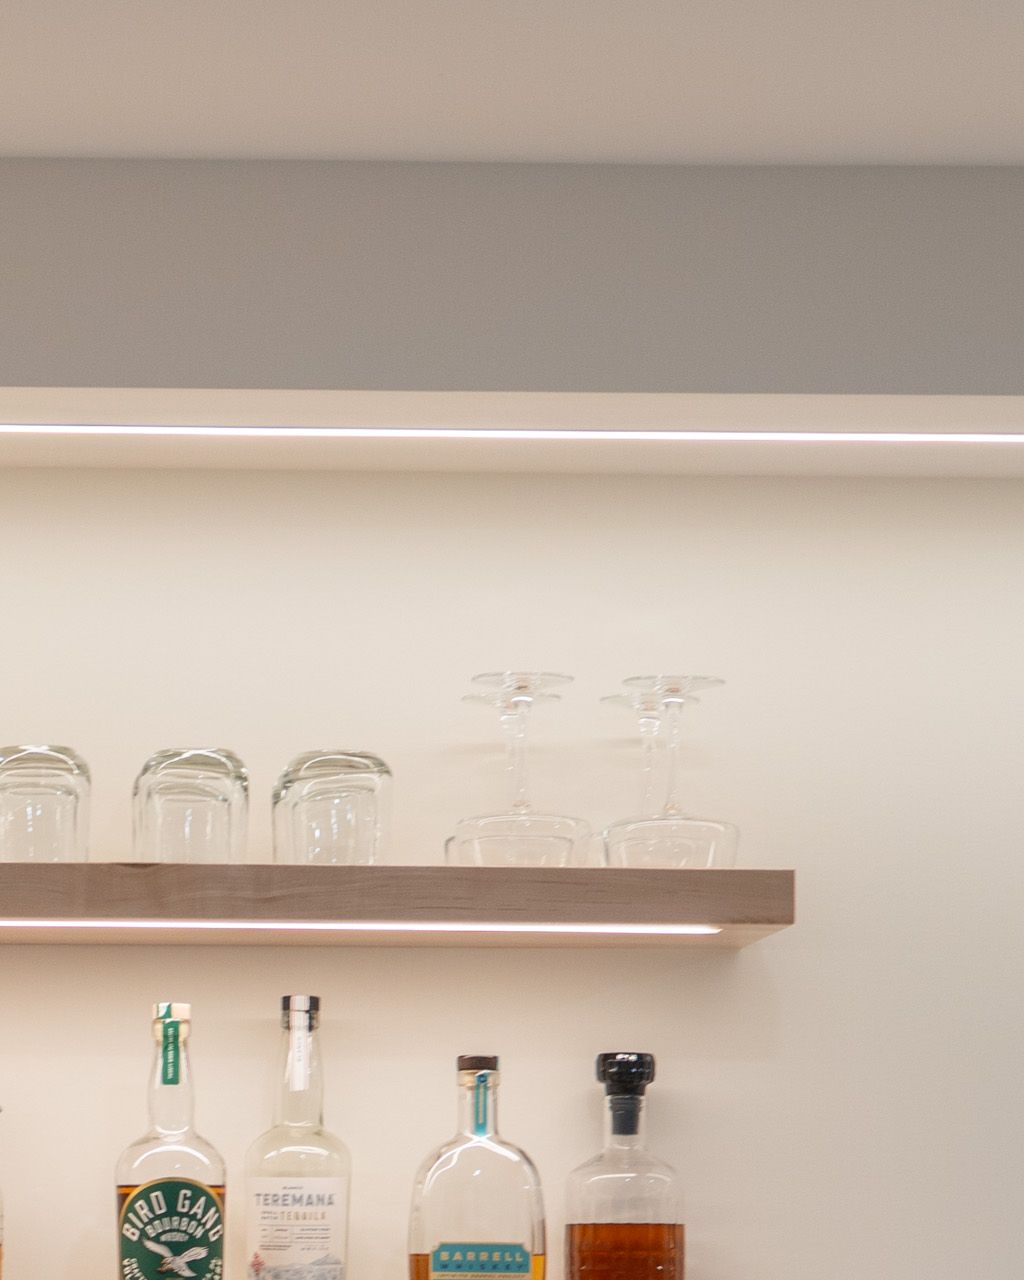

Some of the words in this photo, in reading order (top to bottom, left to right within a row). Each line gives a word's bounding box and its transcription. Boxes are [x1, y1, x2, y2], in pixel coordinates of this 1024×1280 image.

[254, 1193, 335, 1208] TEREMANA
[122, 1190, 168, 1242] BIRD
[176, 1189, 224, 1242] GANG
[144, 1216, 203, 1239] BOURBON
